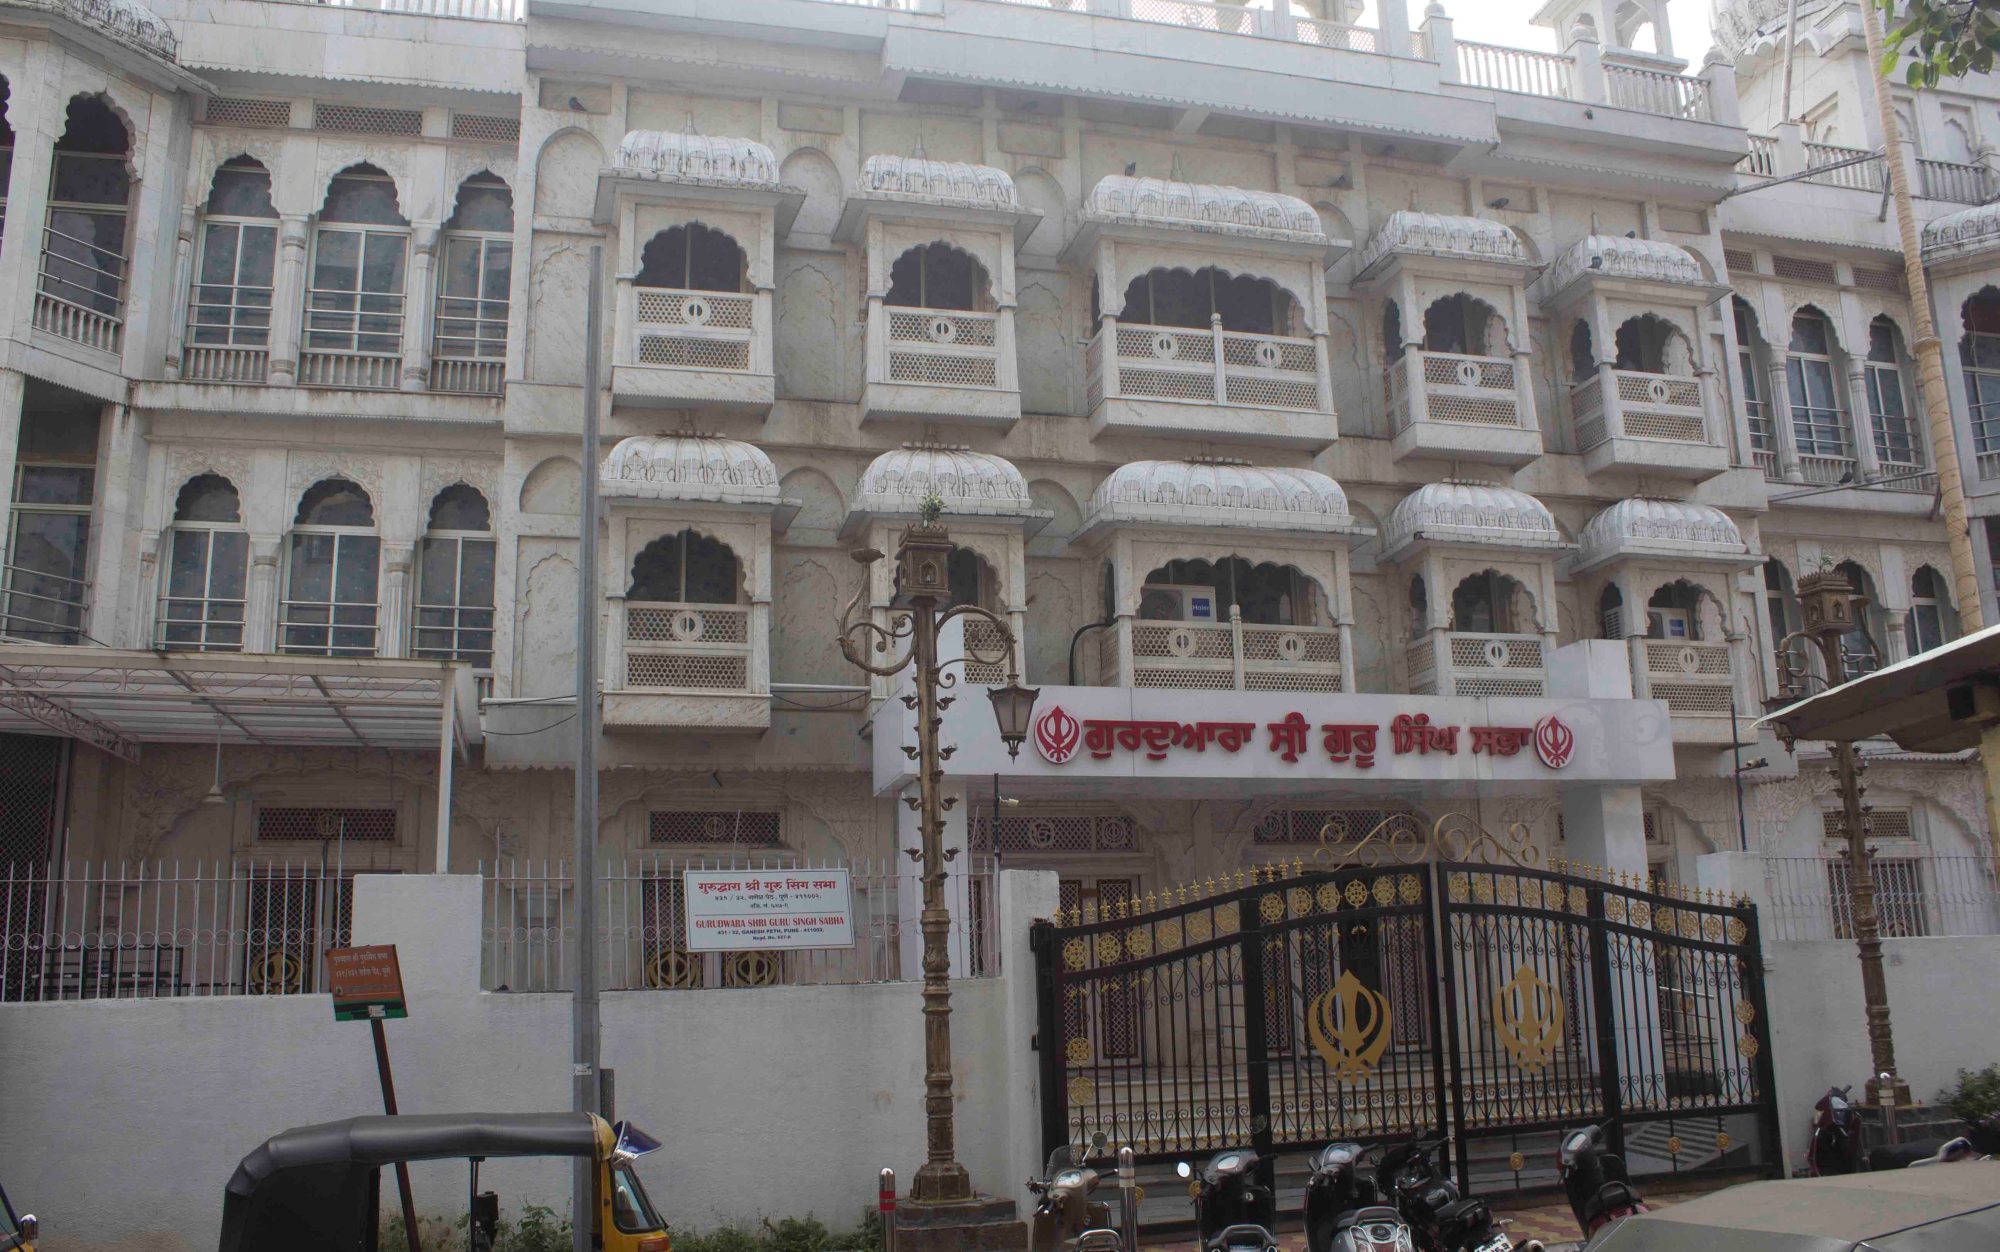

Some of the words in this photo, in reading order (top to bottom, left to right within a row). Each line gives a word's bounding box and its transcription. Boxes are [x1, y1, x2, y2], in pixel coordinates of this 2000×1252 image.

[1083, 719, 1256, 761] ਗੁਰਦੁਆਰਾ
[1267, 711, 1311, 763] ਸ੍ਰੀ
[1321, 724, 1380, 768] ਗੁਰੂ
[1390, 713, 1461, 755] ਸਿੰਘ
[1469, 726, 1533, 757] ਸਭਾ
[697, 881, 741, 895] गुरुद्वारा
[745, 879, 760, 891] श्री
[764, 881, 783, 893] गुरु
[813, 880, 836, 890] सभा
[696, 919, 746, 929] GURUDWARA
[748, 918, 767, 928] SHRI
[769, 917, 791, 927] GURU
[793, 917, 817, 926] SINGH
[819, 916, 845, 925] SABHA
